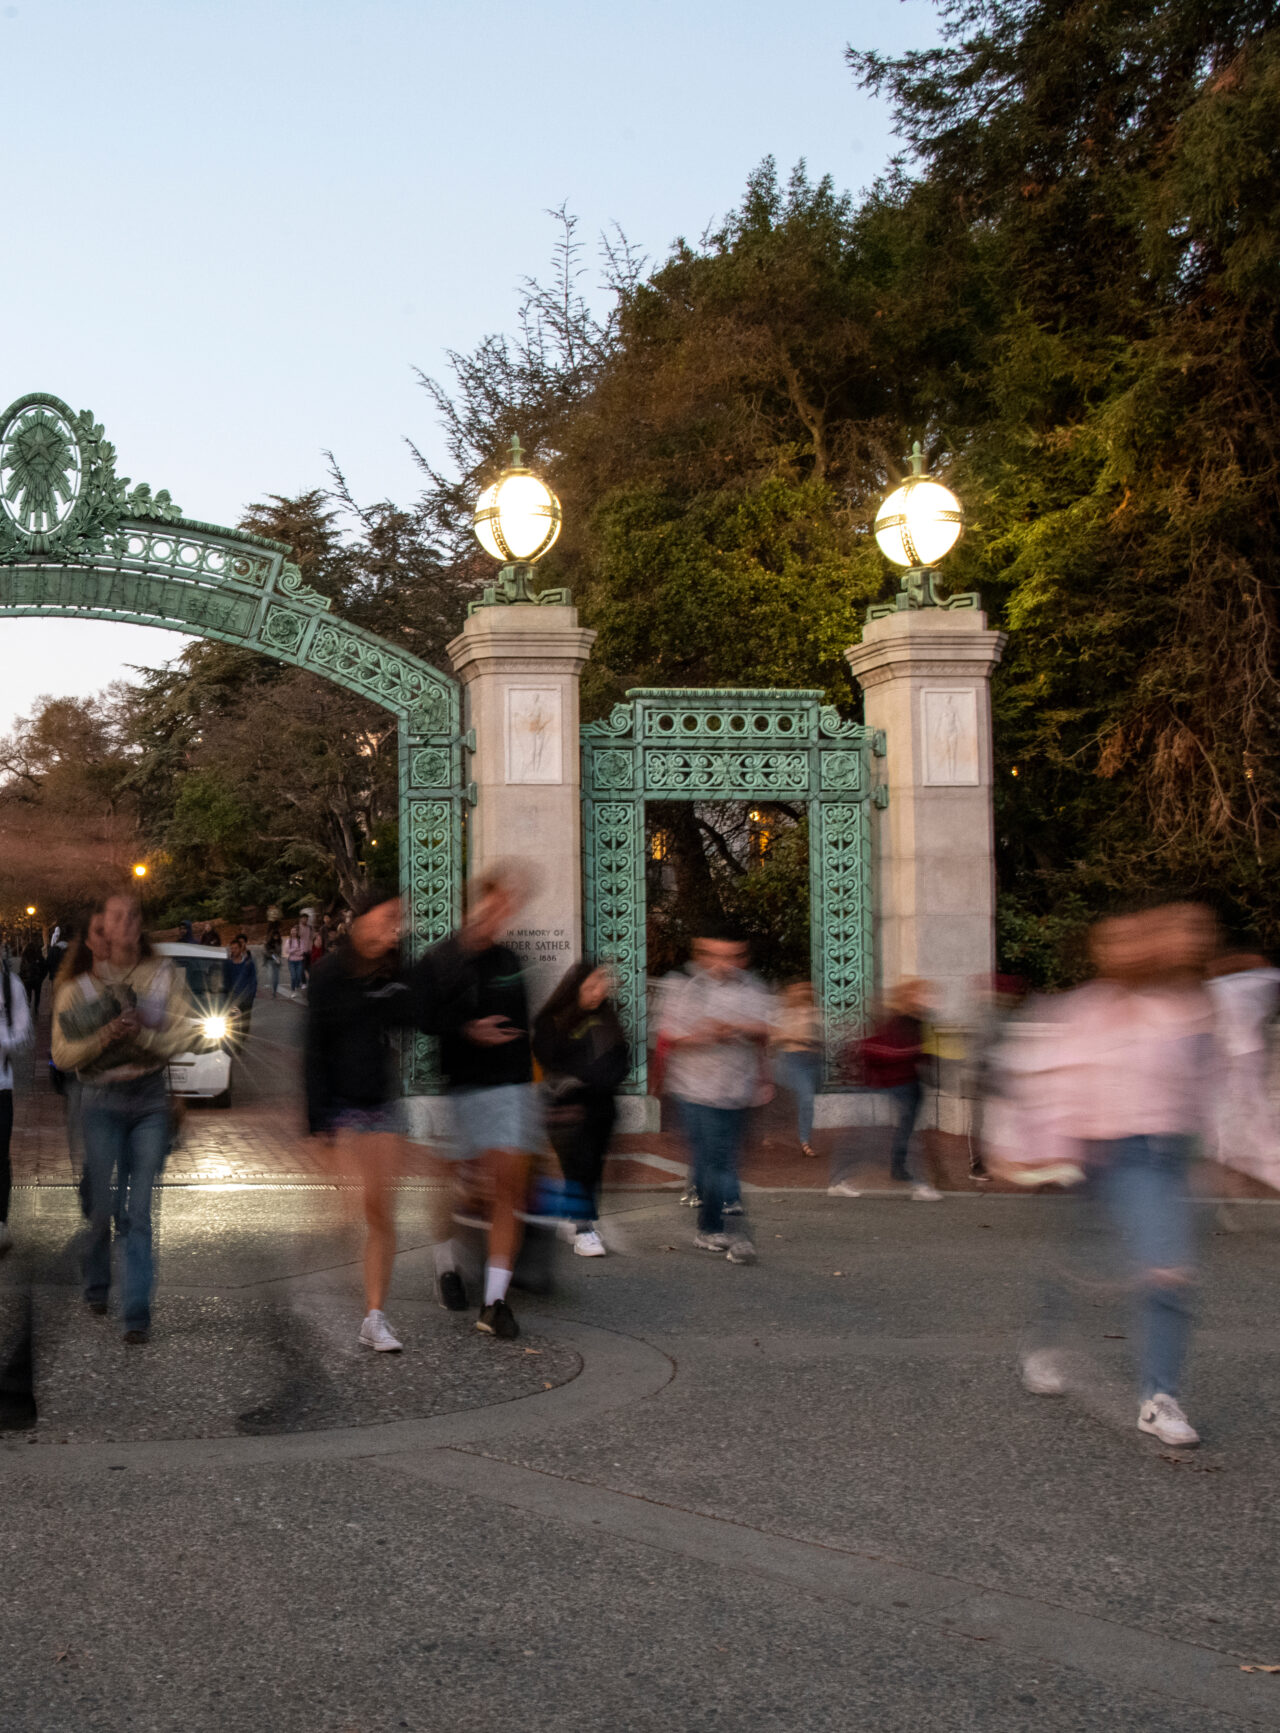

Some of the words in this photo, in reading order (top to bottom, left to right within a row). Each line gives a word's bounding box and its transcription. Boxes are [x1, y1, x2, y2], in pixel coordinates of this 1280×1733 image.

[517, 929, 551, 937] MEMORY
[553, 929, 565, 937] OF
[535, 941, 571, 950] SATHER
[539, 954, 557, 962] 1886
